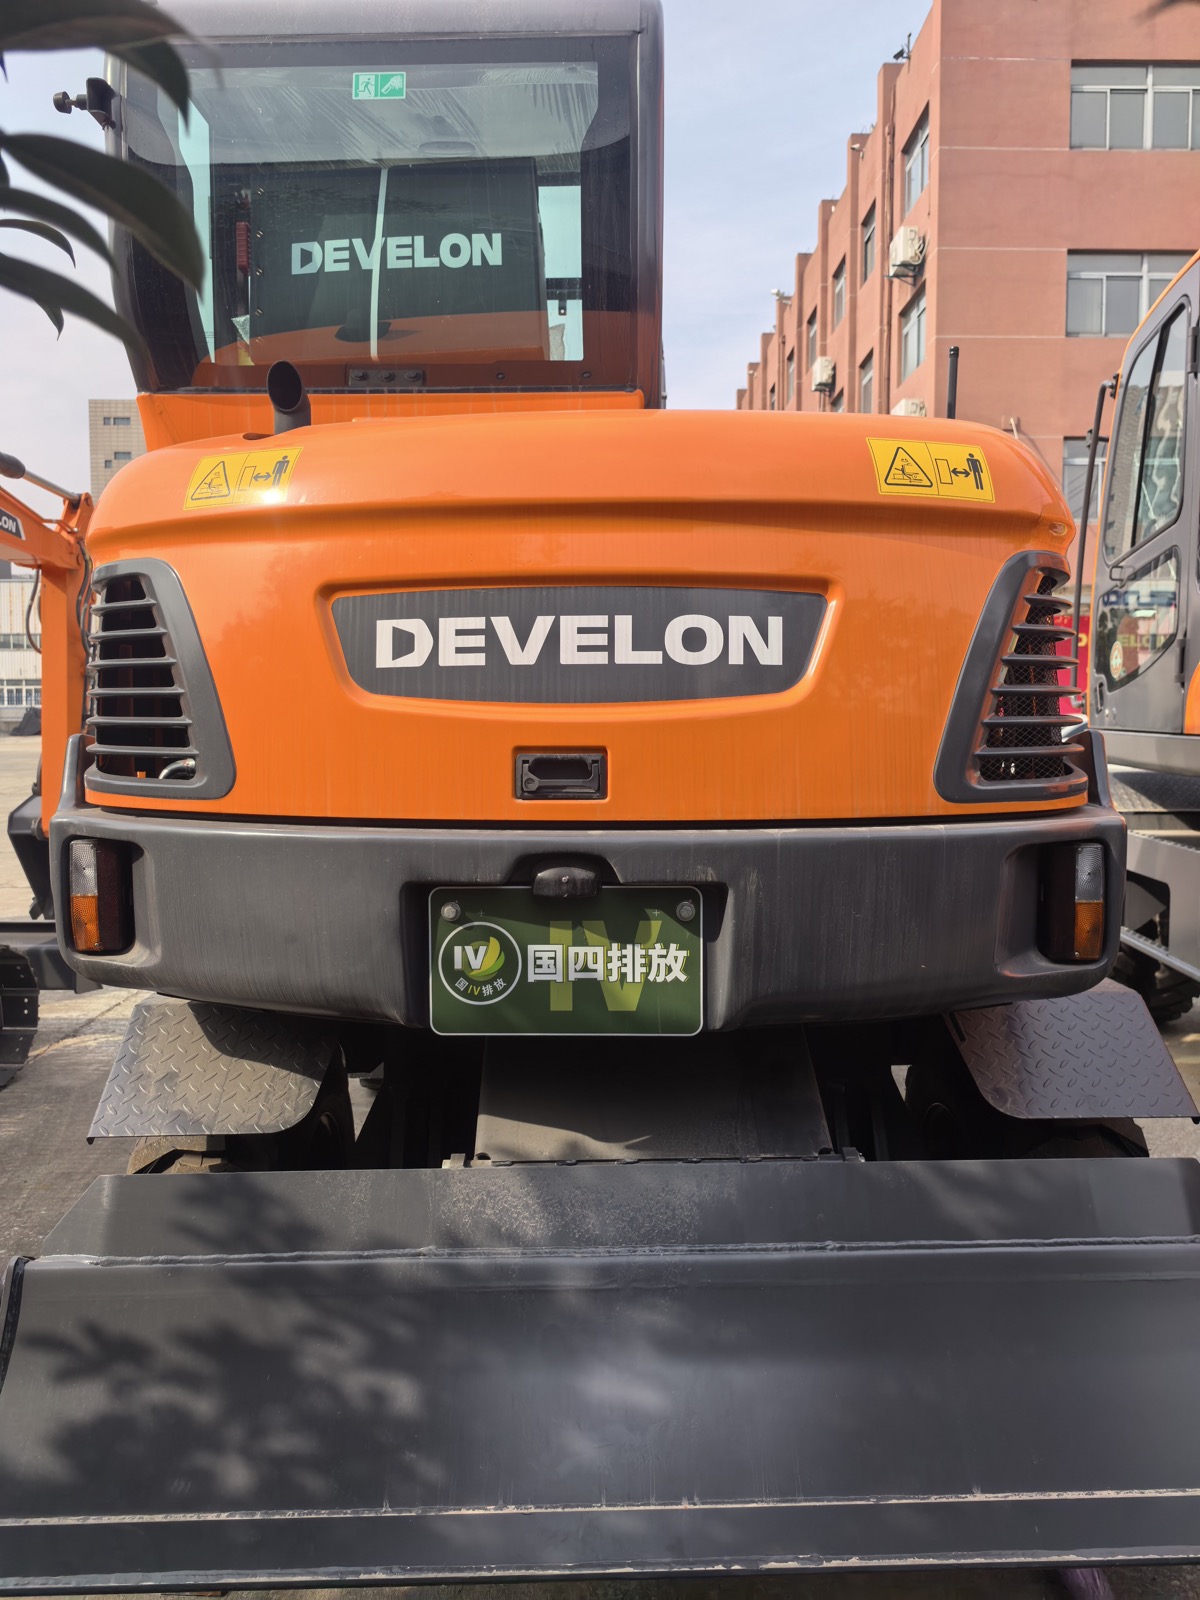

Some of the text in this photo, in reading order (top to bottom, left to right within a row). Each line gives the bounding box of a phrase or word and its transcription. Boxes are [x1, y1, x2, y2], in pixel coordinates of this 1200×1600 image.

[291, 233, 502, 275] DEVELON
[375, 614, 784, 669] DEVELON
[453, 945, 488, 970] IV
[527, 942, 689, 983] 国四排放
[455, 977, 507, 997] 国IV排放
